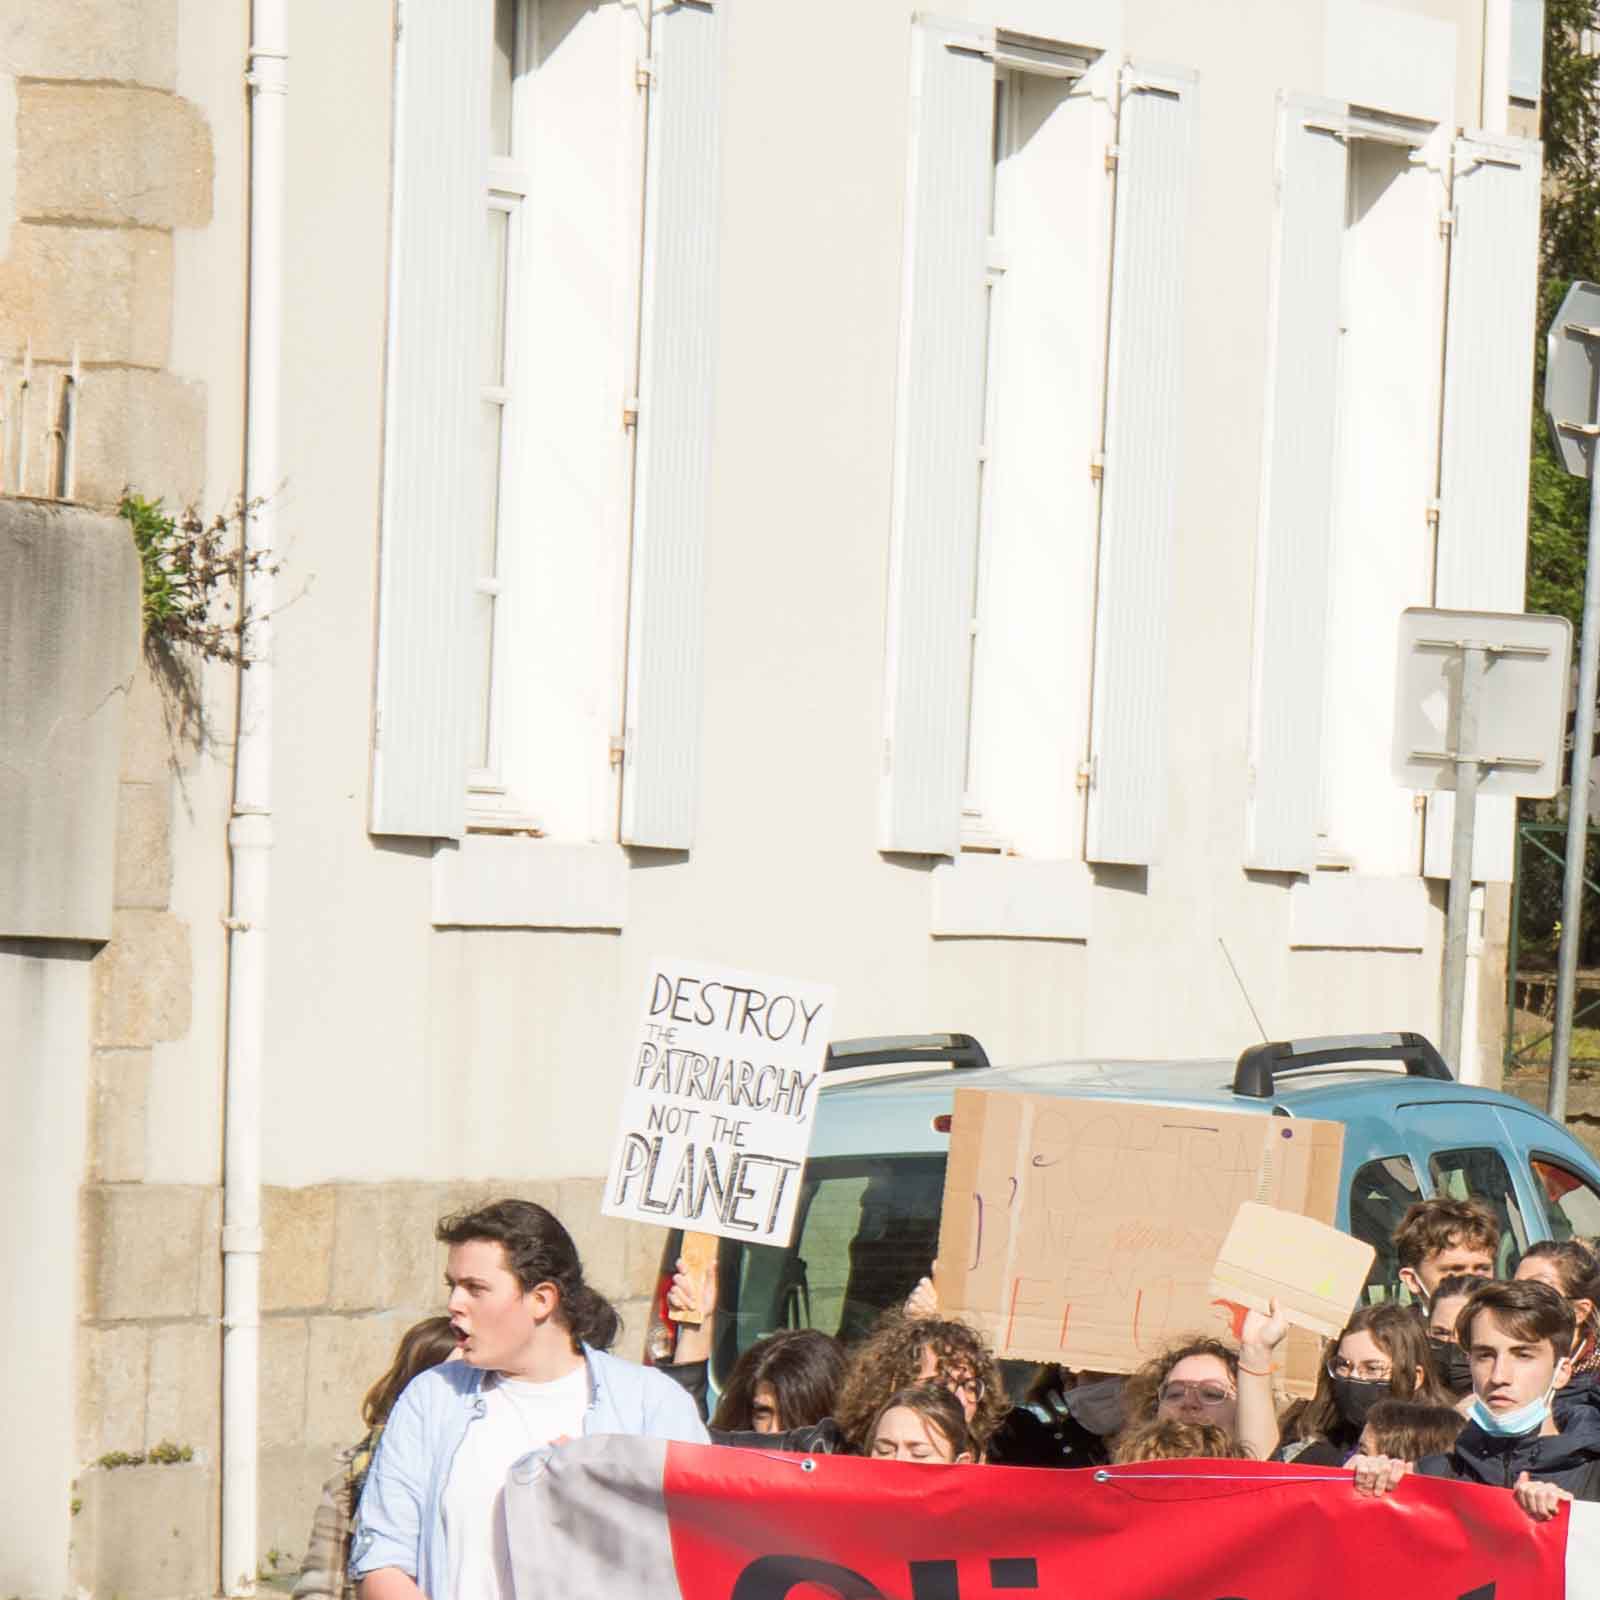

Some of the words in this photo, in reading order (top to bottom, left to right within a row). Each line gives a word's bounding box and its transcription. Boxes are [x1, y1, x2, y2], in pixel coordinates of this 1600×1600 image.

[644, 1023, 679, 1044] THE
[649, 973, 823, 1045] DESTROY
[633, 1042, 817, 1124] PATRIARCHY,
[647, 1103, 700, 1137] NOT
[710, 1114, 752, 1148] THE
[614, 1132, 801, 1234] PLANET
